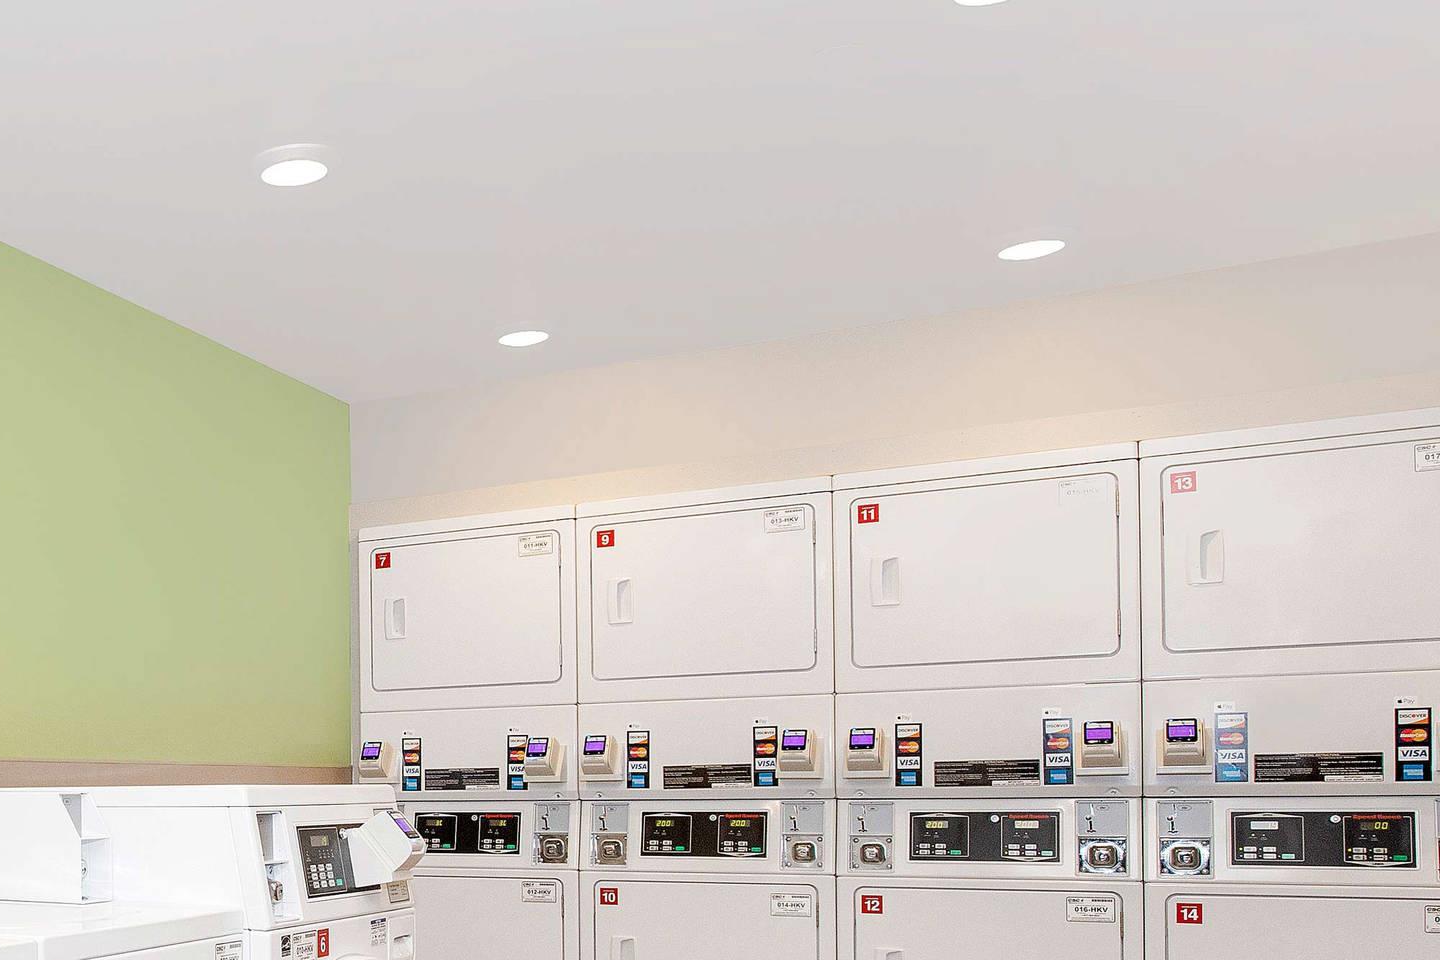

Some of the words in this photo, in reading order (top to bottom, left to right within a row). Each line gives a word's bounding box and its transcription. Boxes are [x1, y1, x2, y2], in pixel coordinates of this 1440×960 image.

[1173, 477, 1193, 489] 13
[860, 508, 876, 521] 11
[601, 534, 610, 545] 9
[379, 556, 387, 567] 7
[1219, 752, 1244, 760] VISA
[1401, 749, 1428, 757] VISA
[730, 819, 746, 827] 200
[602, 892, 616, 903] 10
[864, 900, 880, 912] 12
[1180, 908, 1199, 921] 14
[320, 936, 326, 953] 6
